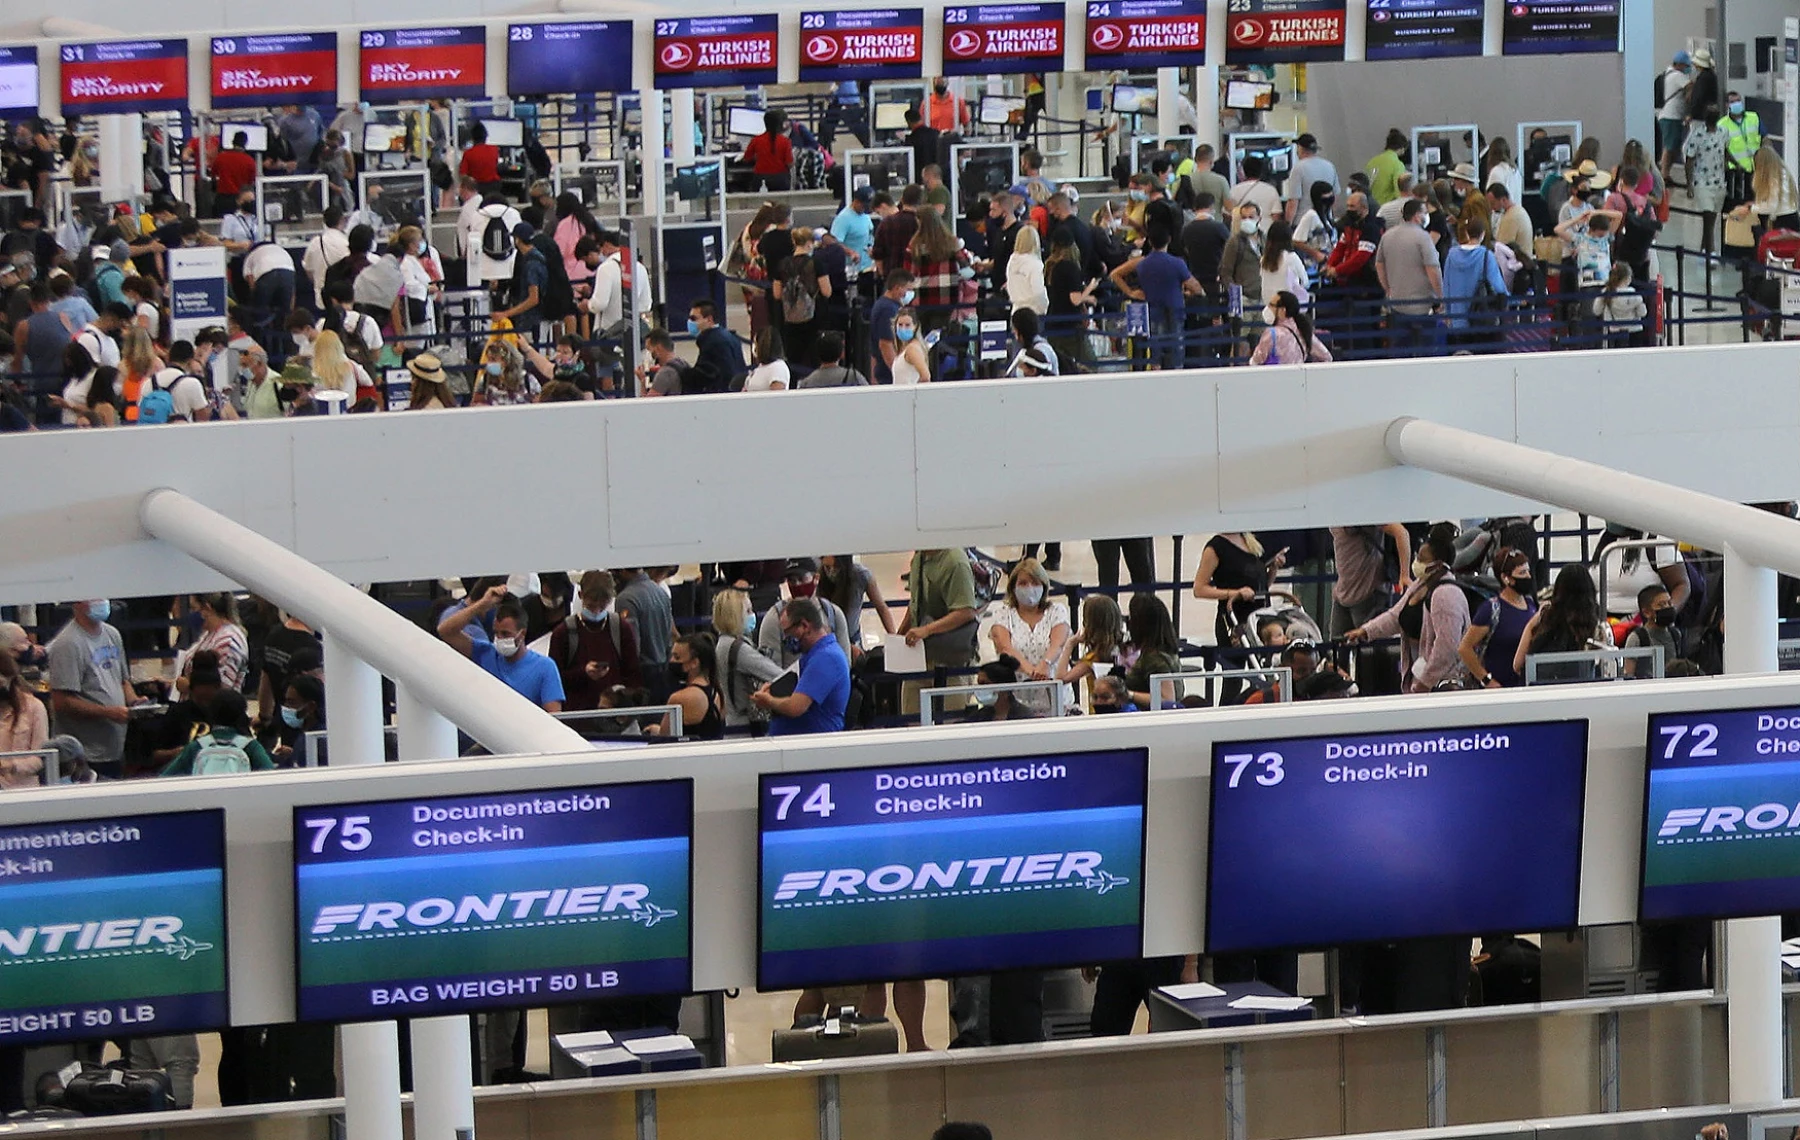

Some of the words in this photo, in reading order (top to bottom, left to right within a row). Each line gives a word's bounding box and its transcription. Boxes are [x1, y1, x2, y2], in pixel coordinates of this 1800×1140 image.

[1089, 4, 1110, 18] 24
[1230, 0, 1251, 12] 23
[1532, 6, 1571, 15] TURKISH
[1572, 4, 1614, 13] AIRLINES
[803, 14, 825, 28] 26
[945, 9, 967, 23] 25
[1394, 10, 1435, 20] TURKISH
[1436, 8, 1478, 18] AIRLINES
[657, 21, 679, 36] 27
[1129, 22, 1199, 36] TURKISH
[1269, 18, 1339, 31] TURKISH
[362, 33, 385, 47] 29
[511, 26, 533, 41] 28
[843, 33, 915, 47] TURKISH
[986, 28, 1057, 42] TURKISH
[1128, 34, 1199, 48] AIRLINES
[1268, 29, 1339, 43] AIRLINES
[213, 40, 236, 55] 30
[698, 40, 771, 54] TURKISH
[843, 44, 916, 60] AIRLINES
[985, 39, 1058, 53] AIRLINES
[698, 51, 772, 66] AIRLINES
[221, 70, 262, 81] SKY
[370, 63, 411, 75] SKY
[370, 68, 461, 83] PRIORITY
[71, 76, 112, 88] SKY
[71, 82, 164, 97] PRIORITY
[221, 75, 314, 89] PRIORITY
[1325, 733, 1510, 760] Documentación
[1659, 723, 1720, 759] 72
[875, 762, 1067, 791] Documentación
[1223, 751, 1286, 788] 73
[1324, 761, 1428, 784] Check-in
[412, 794, 610, 823] Documentación
[771, 783, 836, 821] 74
[875, 793, 983, 815] Check-in
[0, 825, 141, 852] mentación
[305, 816, 373, 854] 75
[412, 825, 524, 847] Check-in
[773, 850, 1103, 901] FRONTIER
[311, 883, 650, 934] FRONTIER
[372, 985, 429, 1006] BAG
[436, 976, 542, 999] WEIGHT
[549, 973, 577, 991] 50
[585, 971, 620, 990] LB
[82, 1008, 112, 1027] 50
[120, 1005, 155, 1023] LB
